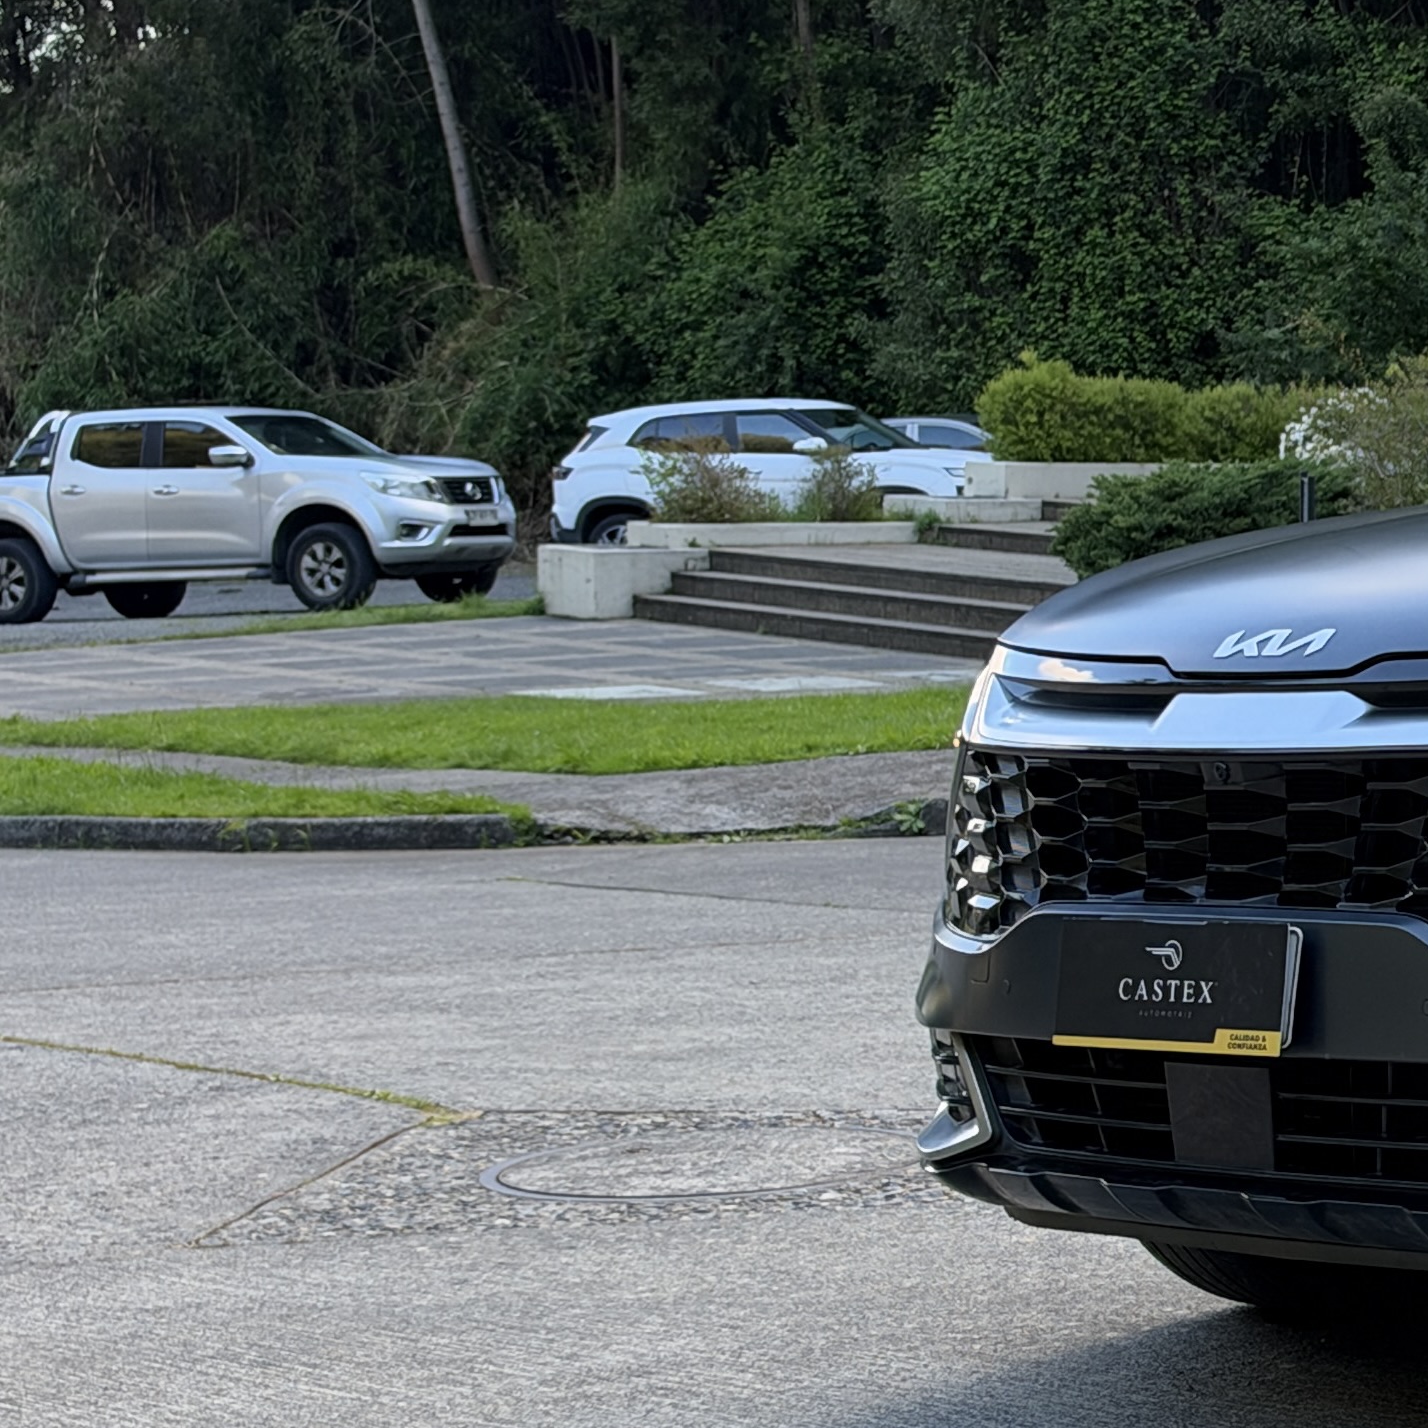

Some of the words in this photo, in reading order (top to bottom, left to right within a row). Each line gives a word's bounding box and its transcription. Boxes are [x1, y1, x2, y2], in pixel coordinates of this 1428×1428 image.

[1212, 628, 1337, 658] KIA
[1118, 976, 1214, 1004] CASTEX
[1227, 1042, 1267, 1051] CONFIANZA
[1229, 1033, 1260, 1042] CALIDAD
